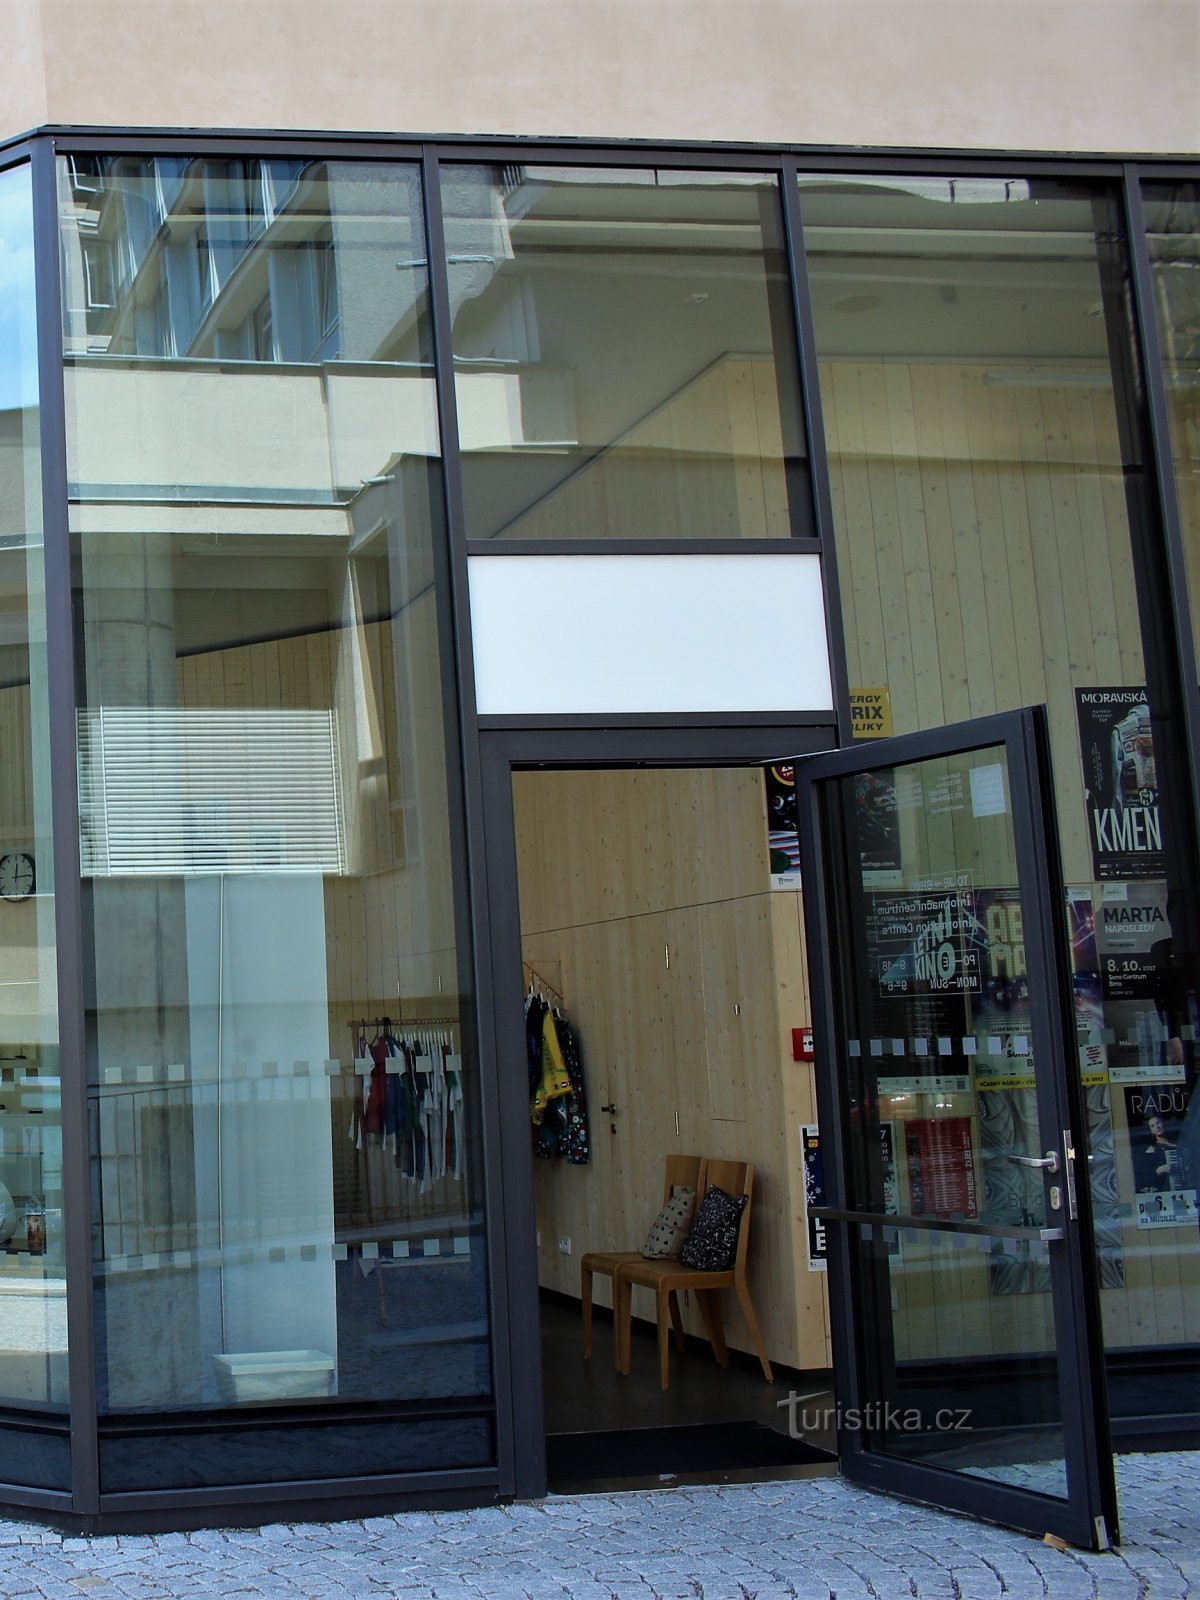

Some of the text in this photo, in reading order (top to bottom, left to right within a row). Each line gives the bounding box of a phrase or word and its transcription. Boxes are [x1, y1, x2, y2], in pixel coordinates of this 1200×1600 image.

[1081, 690, 1148, 703] MORAVSKÁ
[1093, 807, 1162, 852] KMEN
[1103, 907, 1165, 923] MARTA
[1105, 924, 1156, 933] NAPOSLEDY
[914, 942, 956, 981] KINO
[1107, 959, 1119, 972] 8.
[1122, 960, 1141, 972] 10.
